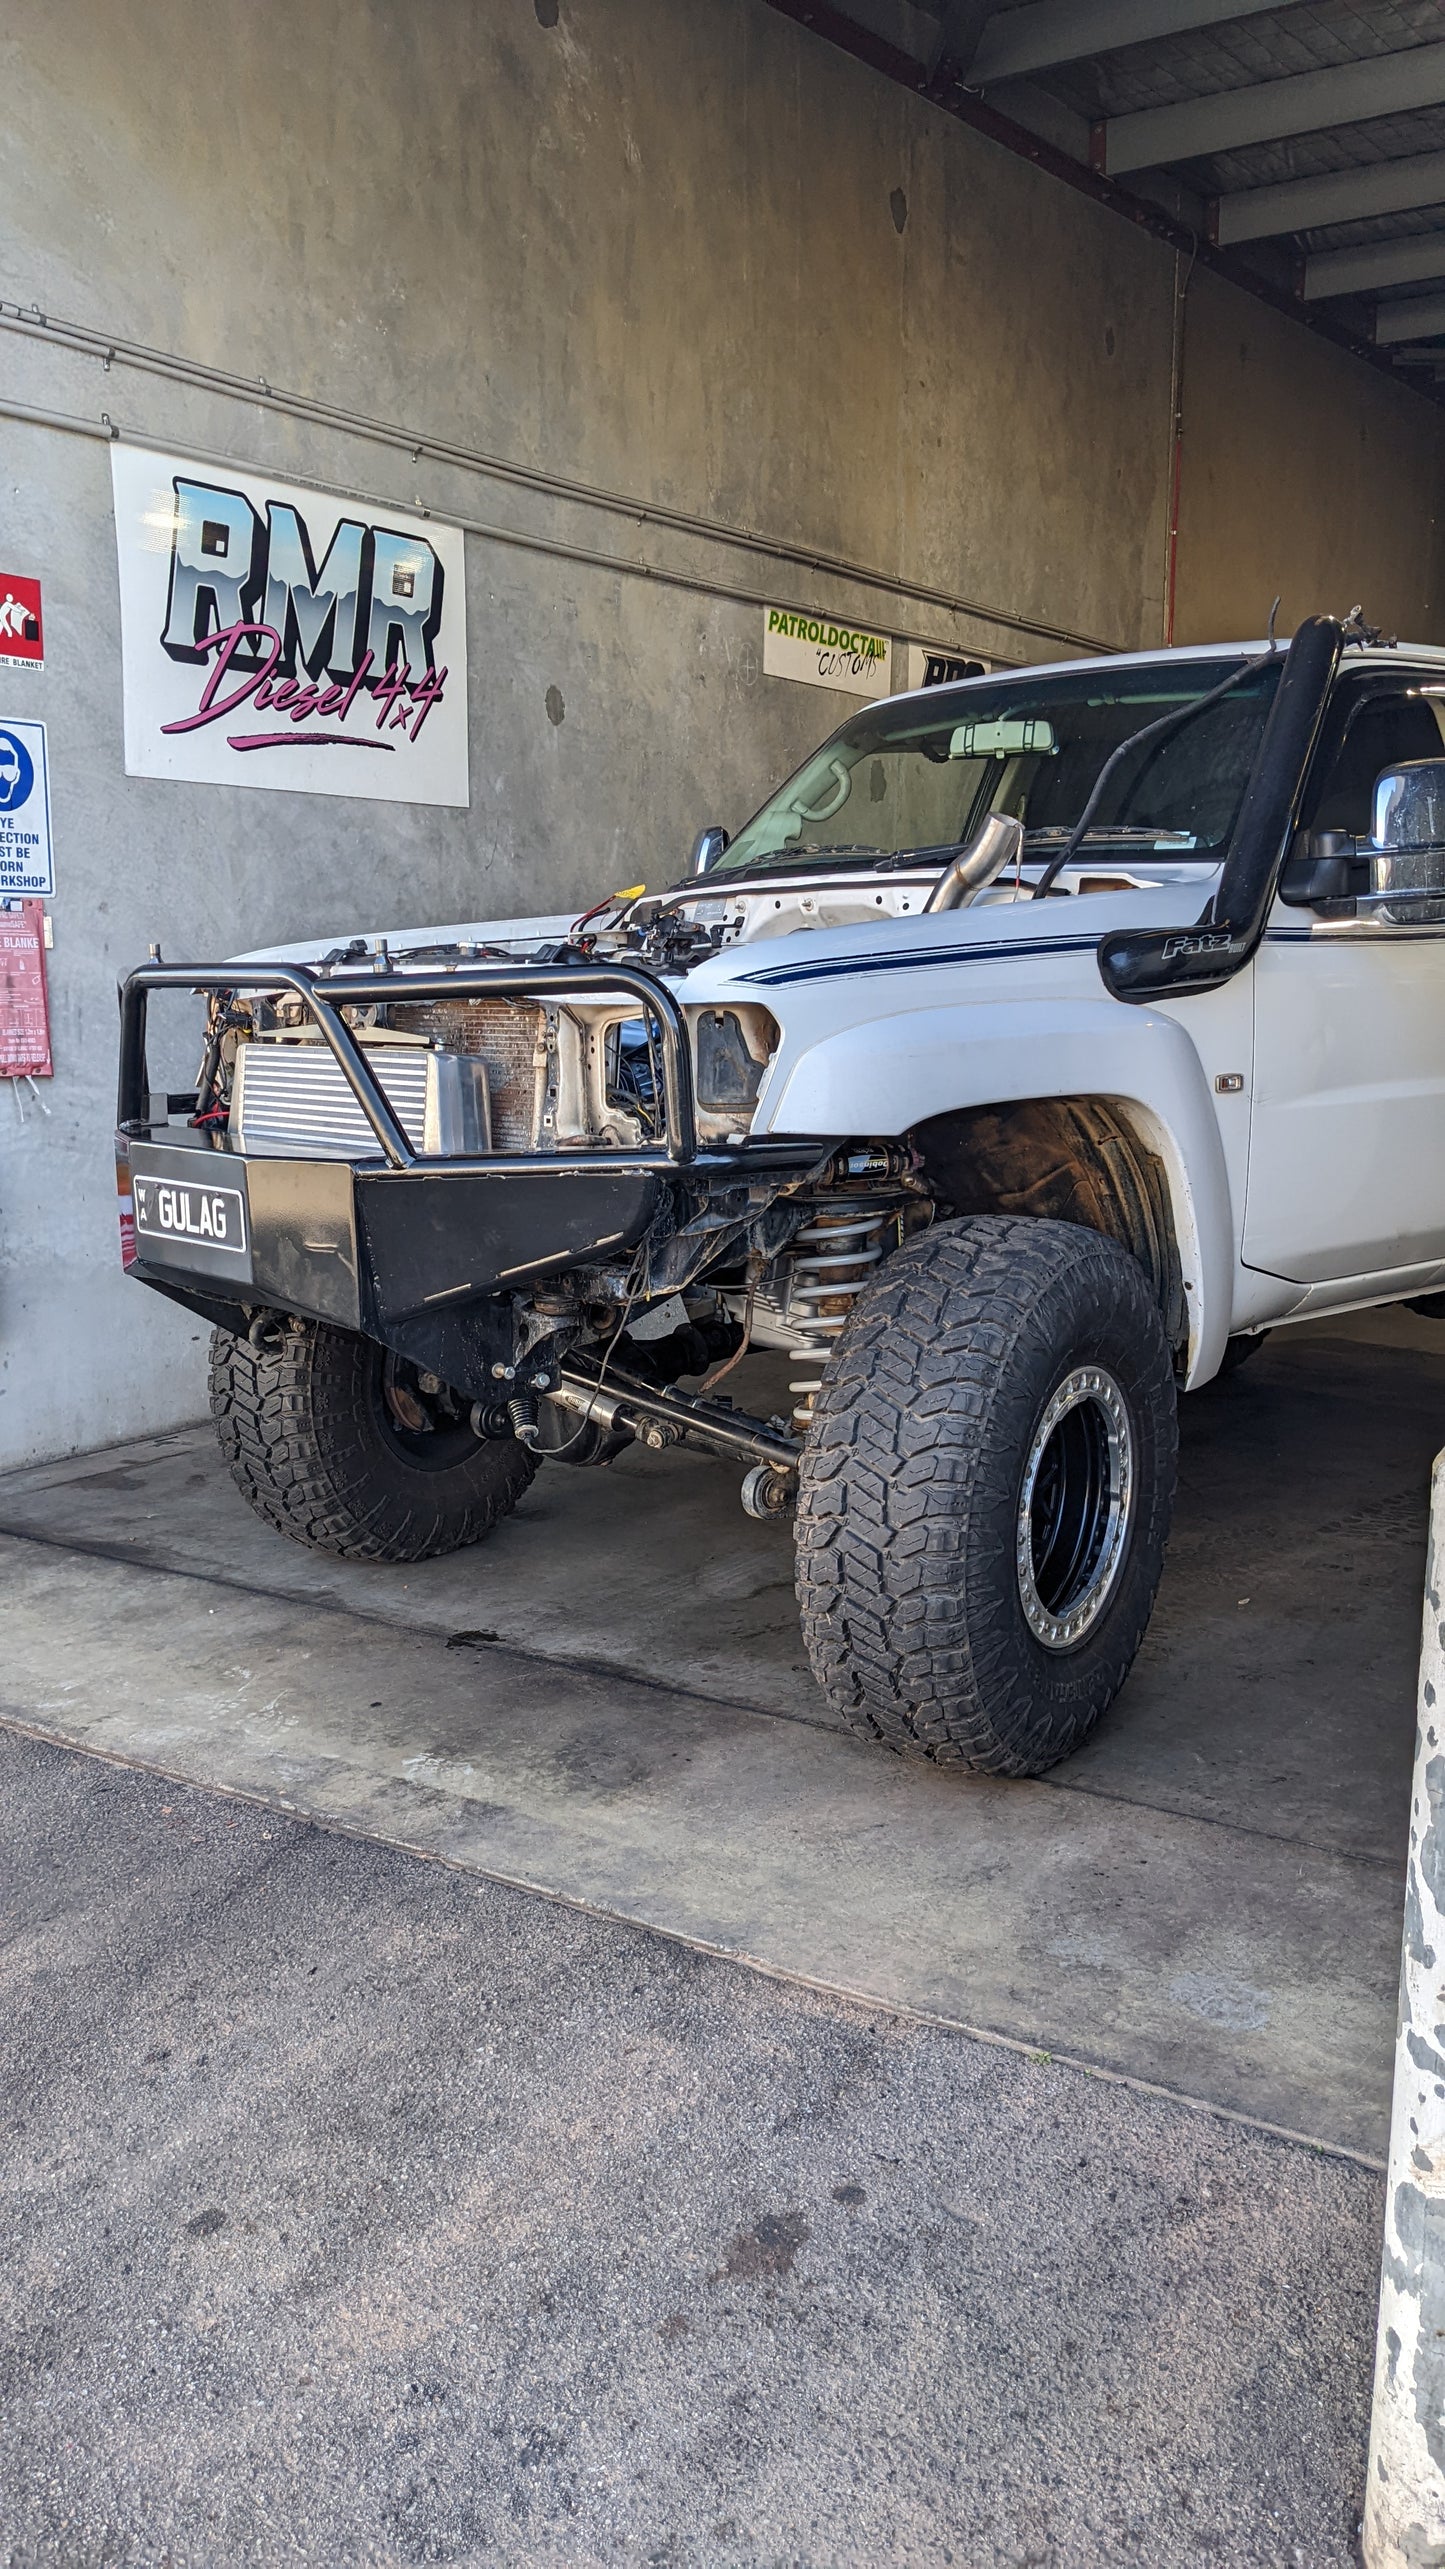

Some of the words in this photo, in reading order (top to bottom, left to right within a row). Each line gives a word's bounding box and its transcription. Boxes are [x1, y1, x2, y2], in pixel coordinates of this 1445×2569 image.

[160, 475, 446, 690] RMR
[13, 658, 43, 670] BLANKET
[160, 619, 372, 736] Diesel
[373, 661, 449, 743] 4x4
[0, 817, 15, 829] YE
[0, 831, 40, 845] ECTION
[0, 846, 13, 858] ST
[16, 847, 31, 859] BE
[0, 860, 24, 873] ORN
[1, 875, 46, 888] RKSHOP
[4, 936, 40, 949] BLANKE
[1161, 933, 1232, 960] Fatz
[158, 1188, 227, 1239] GULAG
